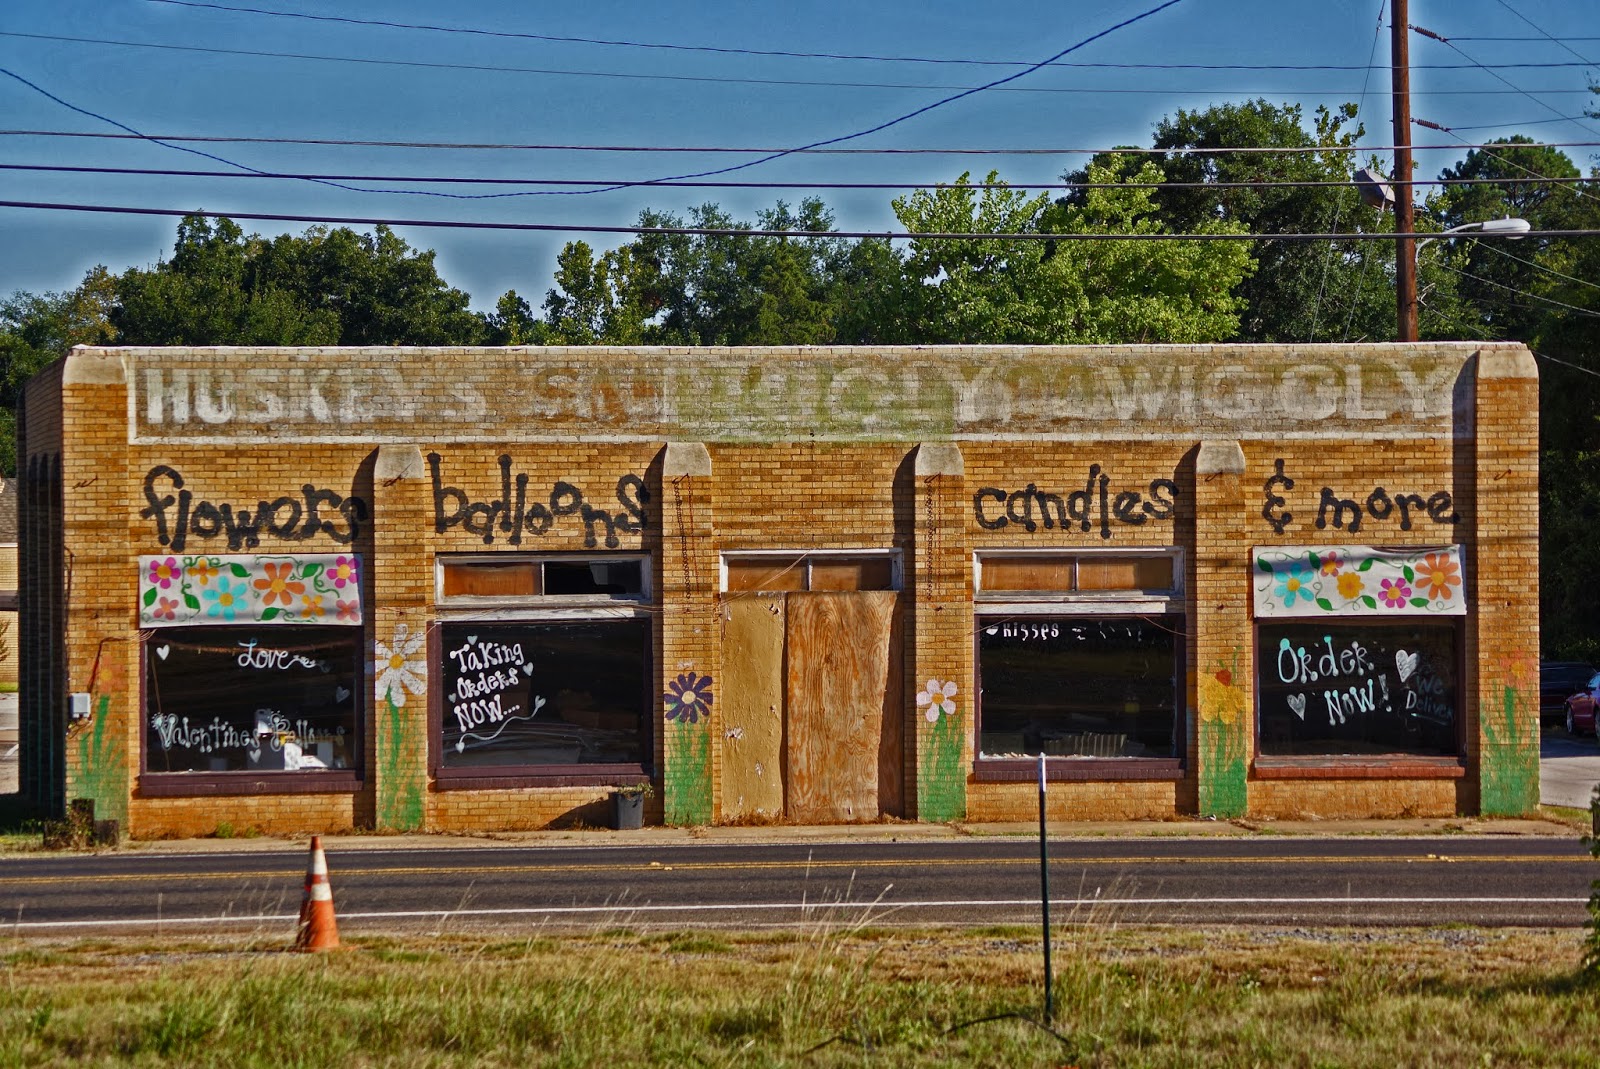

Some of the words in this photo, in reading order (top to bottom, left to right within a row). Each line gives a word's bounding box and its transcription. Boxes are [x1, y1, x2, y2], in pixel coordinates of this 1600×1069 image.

[140, 465, 369, 552] flowers
[973, 463, 1180, 540] candles
[1314, 486, 1462, 534] more
[238, 637, 316, 670] Love
[151, 712, 260, 754] Valentines
